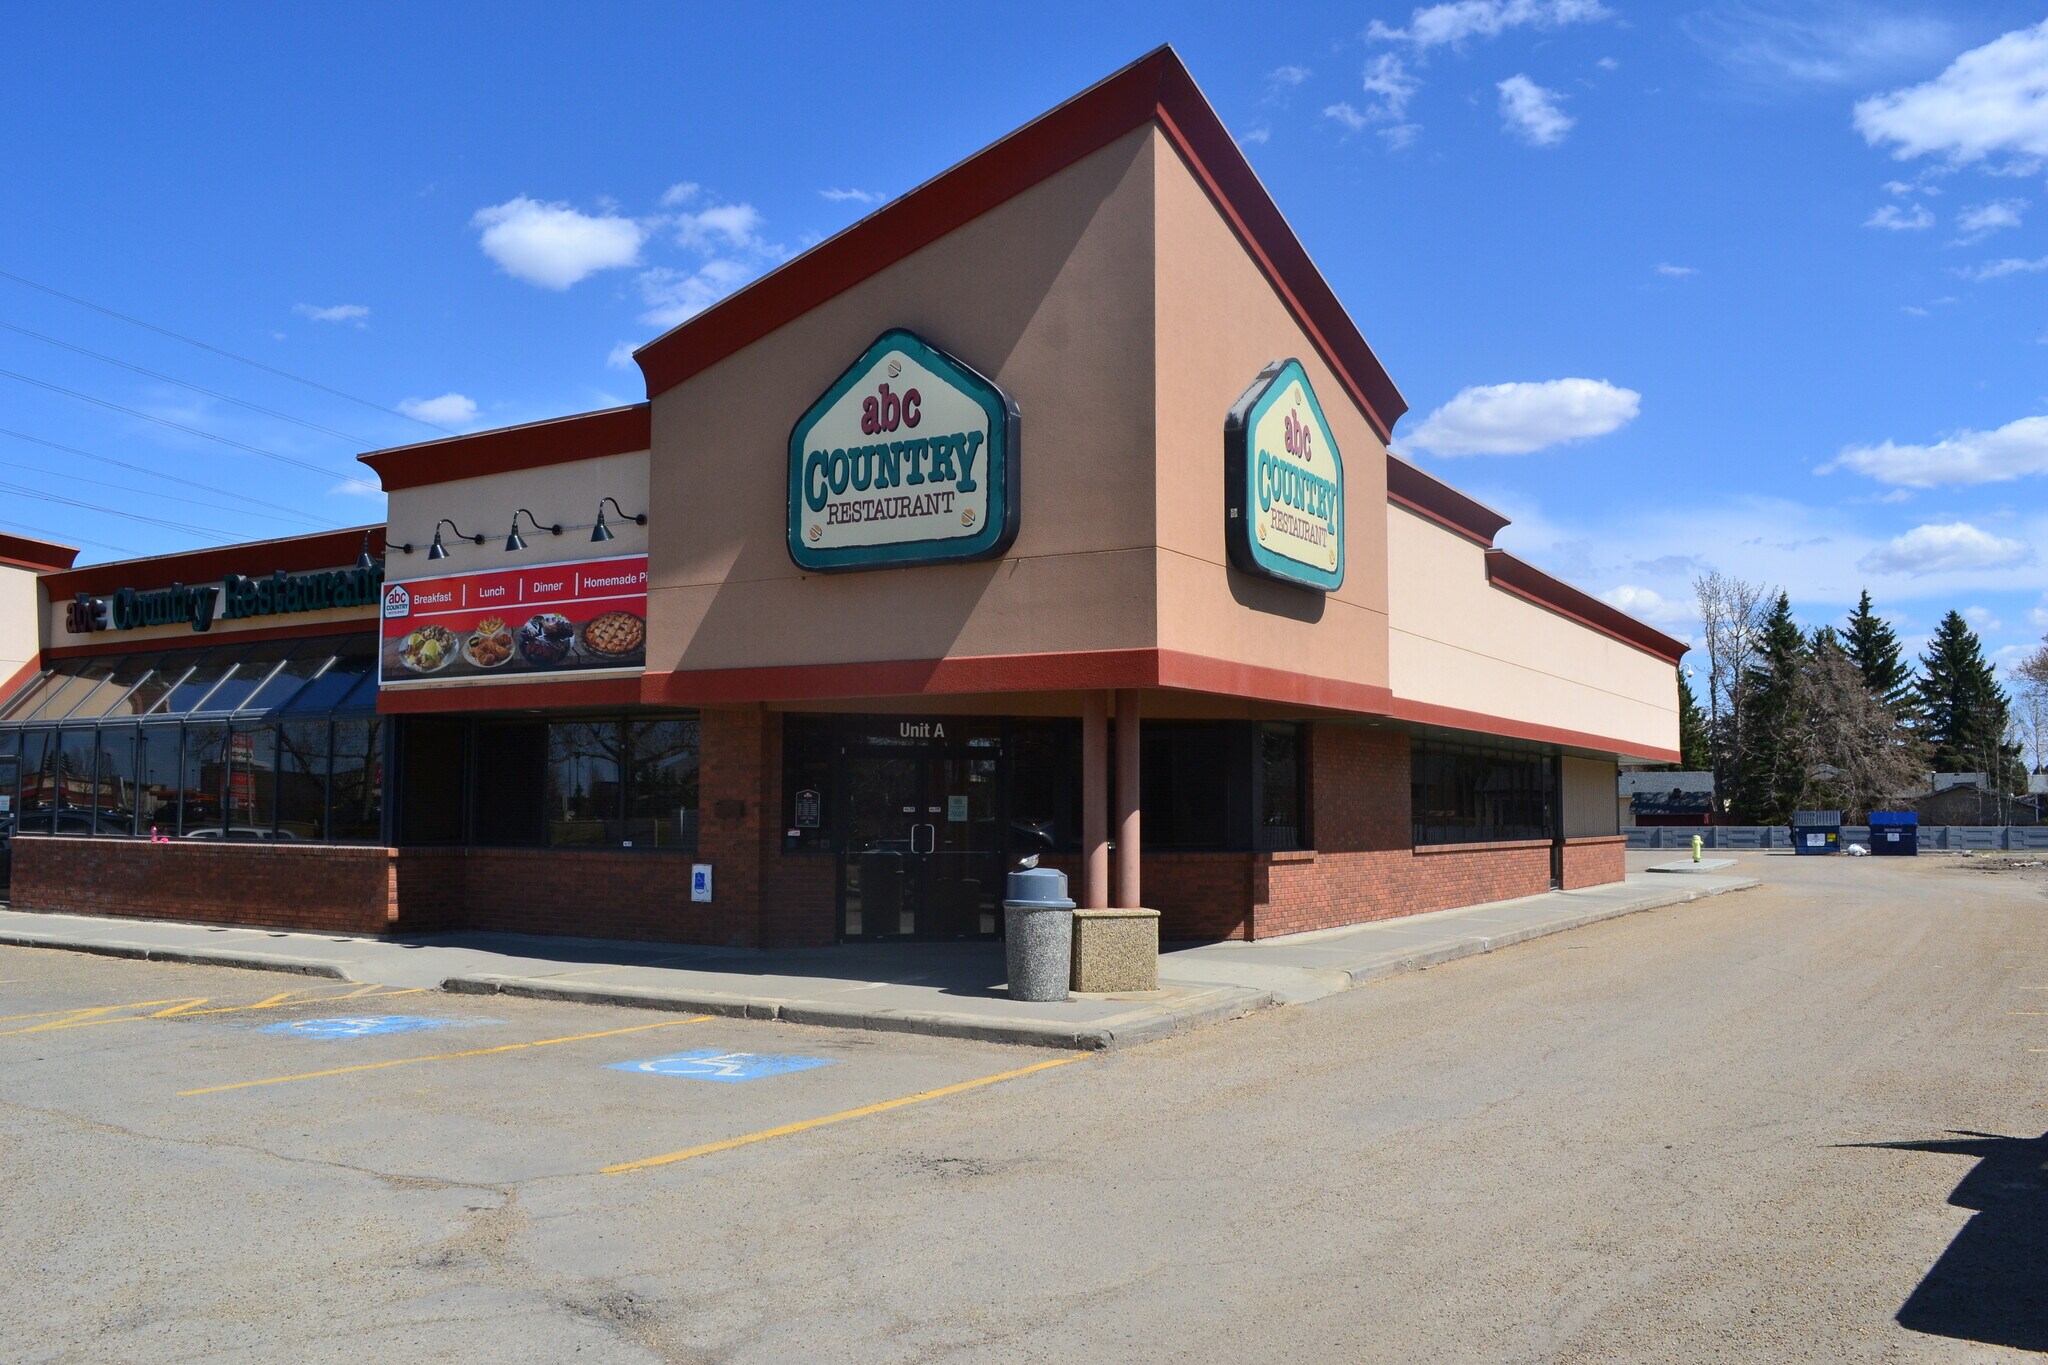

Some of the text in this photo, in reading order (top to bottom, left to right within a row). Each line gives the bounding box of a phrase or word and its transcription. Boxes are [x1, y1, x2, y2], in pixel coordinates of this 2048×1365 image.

[861, 383, 922, 435] abc
[1284, 408, 1312, 462] abc
[804, 430, 984, 512] COUNTRY
[826, 491, 955, 525] RESTAURANT
[1257, 448, 1336, 536] COUNTRY
[1270, 507, 1328, 548] RESTAURANT
[66, 564, 384, 633] abc Country Restaurant
[386, 603, 408, 611] COUNTRY
[388, 589, 406, 604] abc
[414, 591, 452, 605] Breakfast
[479, 584, 505, 598] Lunch
[533, 581, 563, 593] Dinner
[584, 573, 637, 588] Homemade
[899, 722, 945, 738] Unit A
